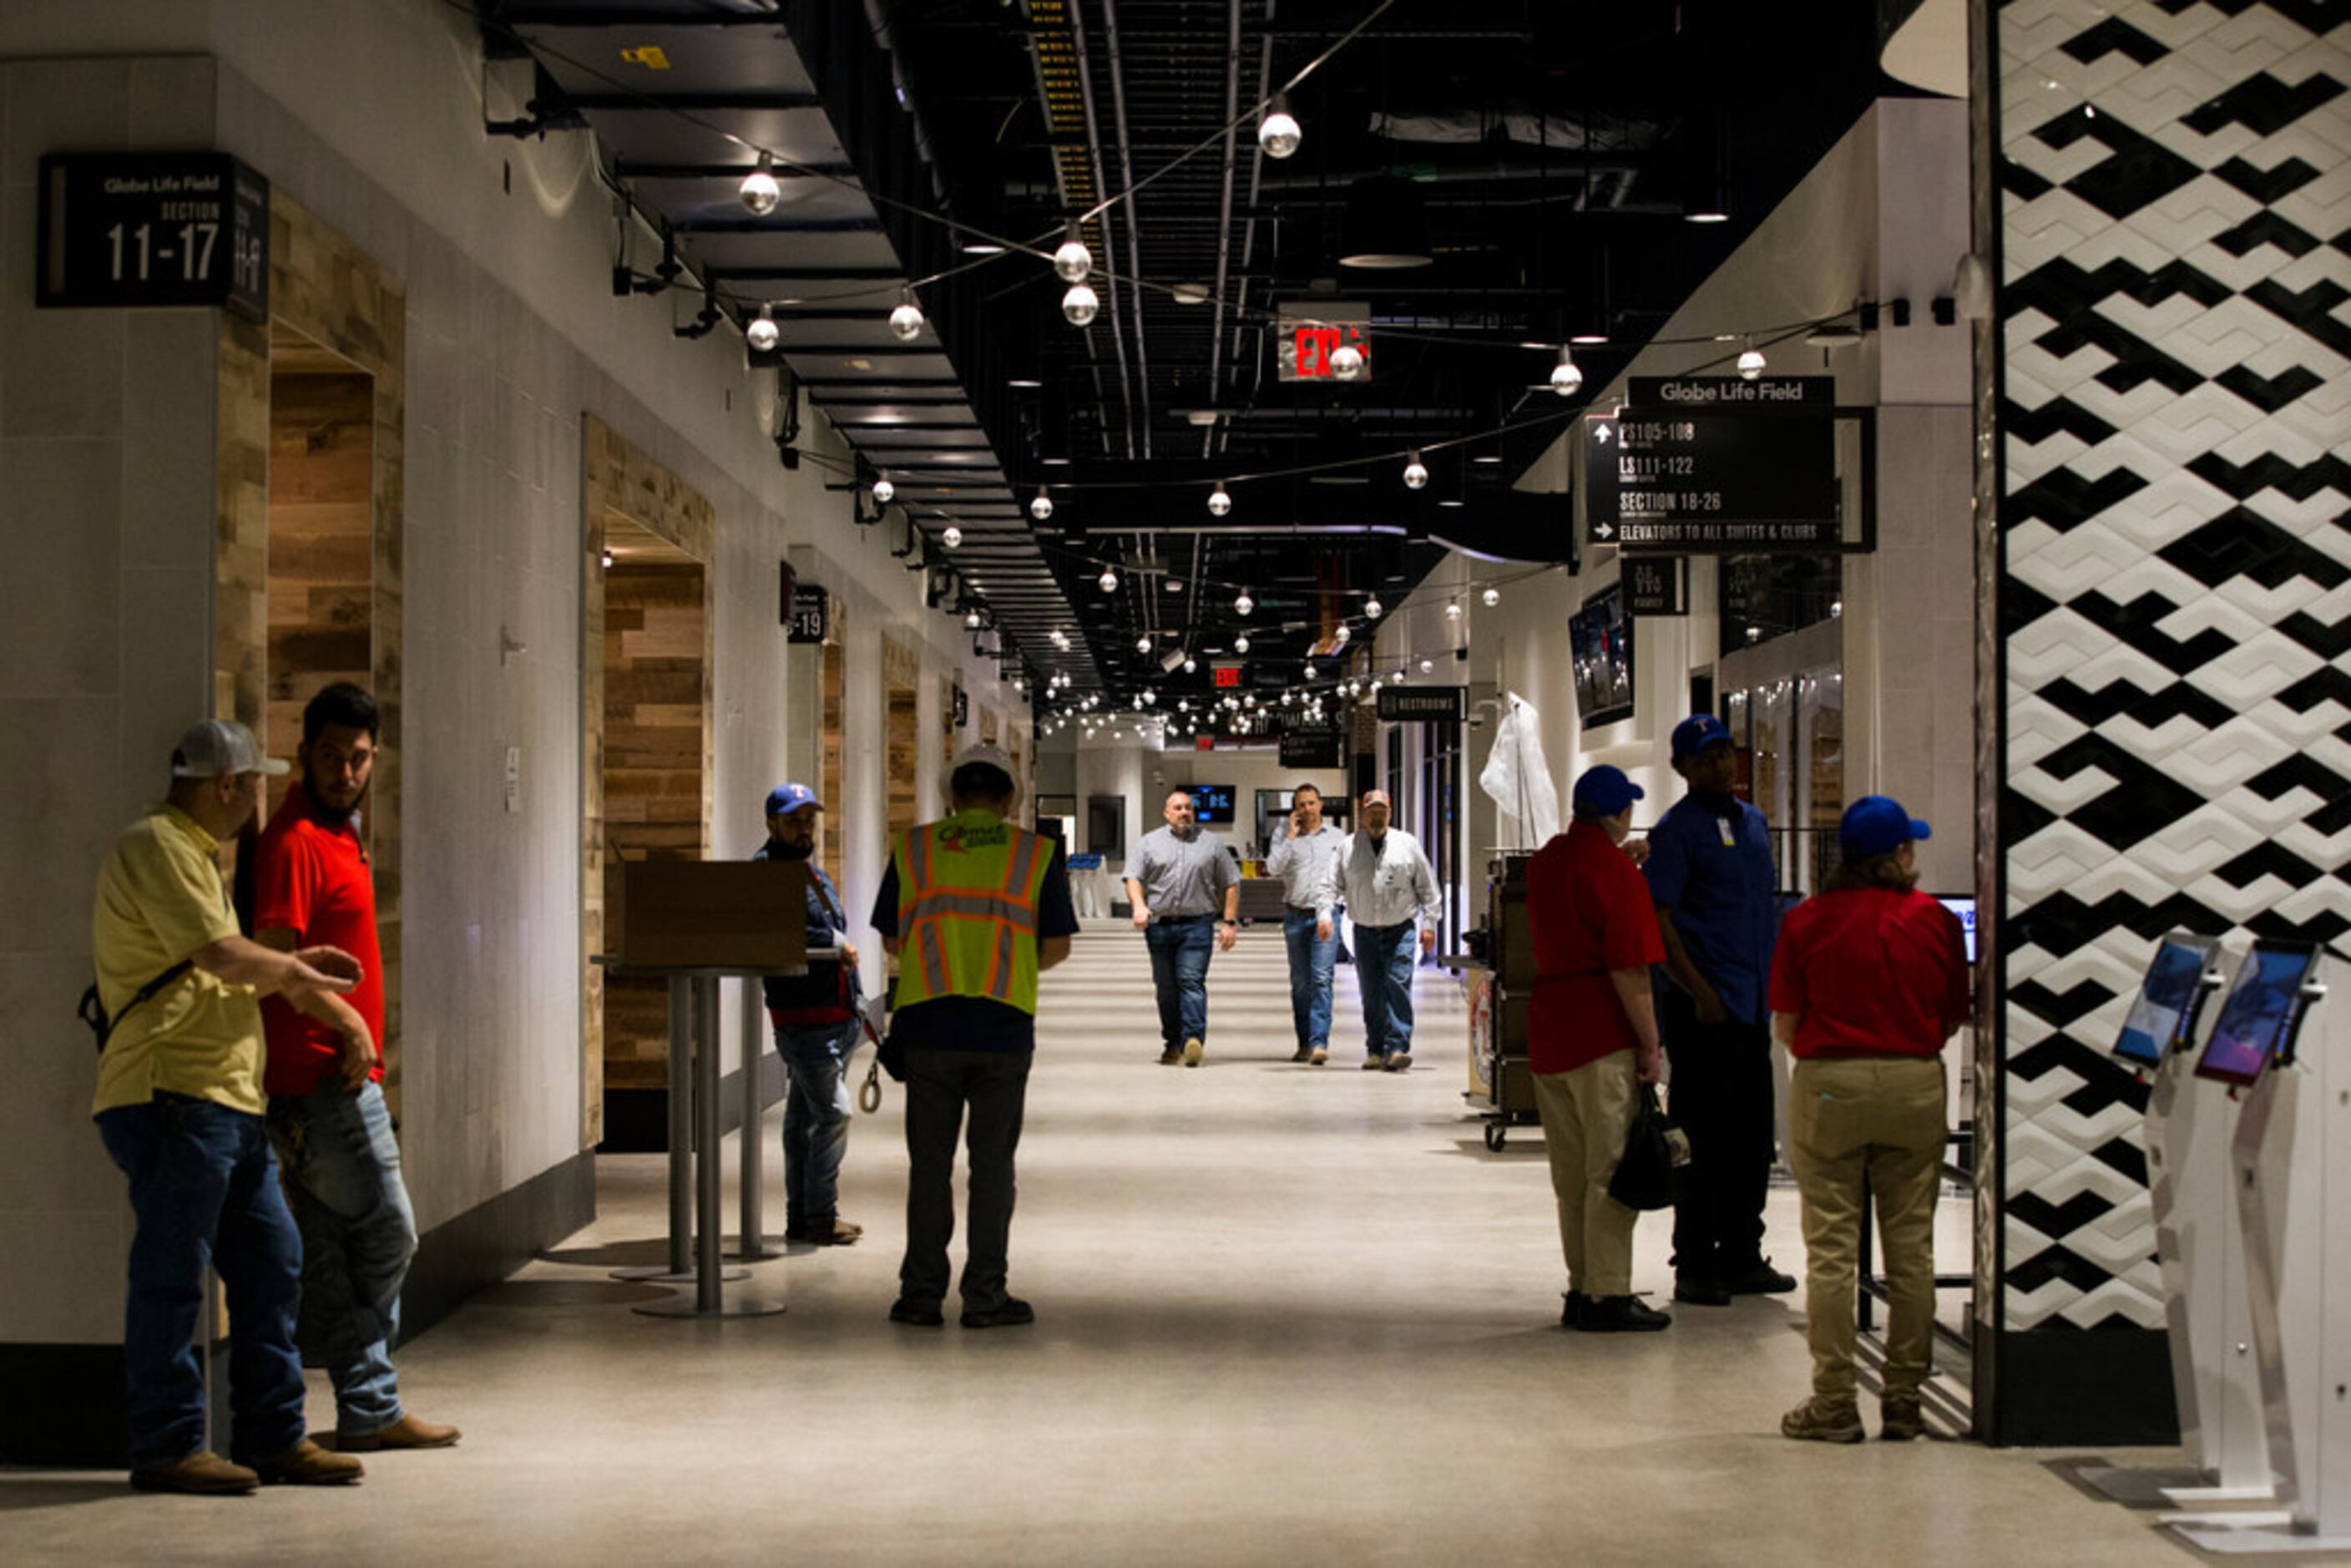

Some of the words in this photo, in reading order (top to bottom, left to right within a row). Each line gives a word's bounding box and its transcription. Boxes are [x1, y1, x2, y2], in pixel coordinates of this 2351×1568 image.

[104, 178, 149, 193] Globe
[153, 176, 180, 192] Life
[183, 175, 219, 191] Field
[162, 202, 220, 220] SECTION
[108, 222, 220, 281] 11-17
[1661, 382, 1716, 400] Globe
[1721, 382, 1755, 400] Life
[1758, 382, 1803, 400] Field
[1619, 456, 1693, 474] LS111-122
[1620, 493, 1676, 510] SECTION
[1681, 493, 1721, 510] 18-26
[1620, 526, 1681, 539] ELEVATORS
[1686, 526, 1699, 539] TO
[1703, 526, 1723, 539] ALL
[1727, 526, 1764, 539] SUITES
[1693, 718, 1709, 733] T
[790, 783, 804, 798] T
